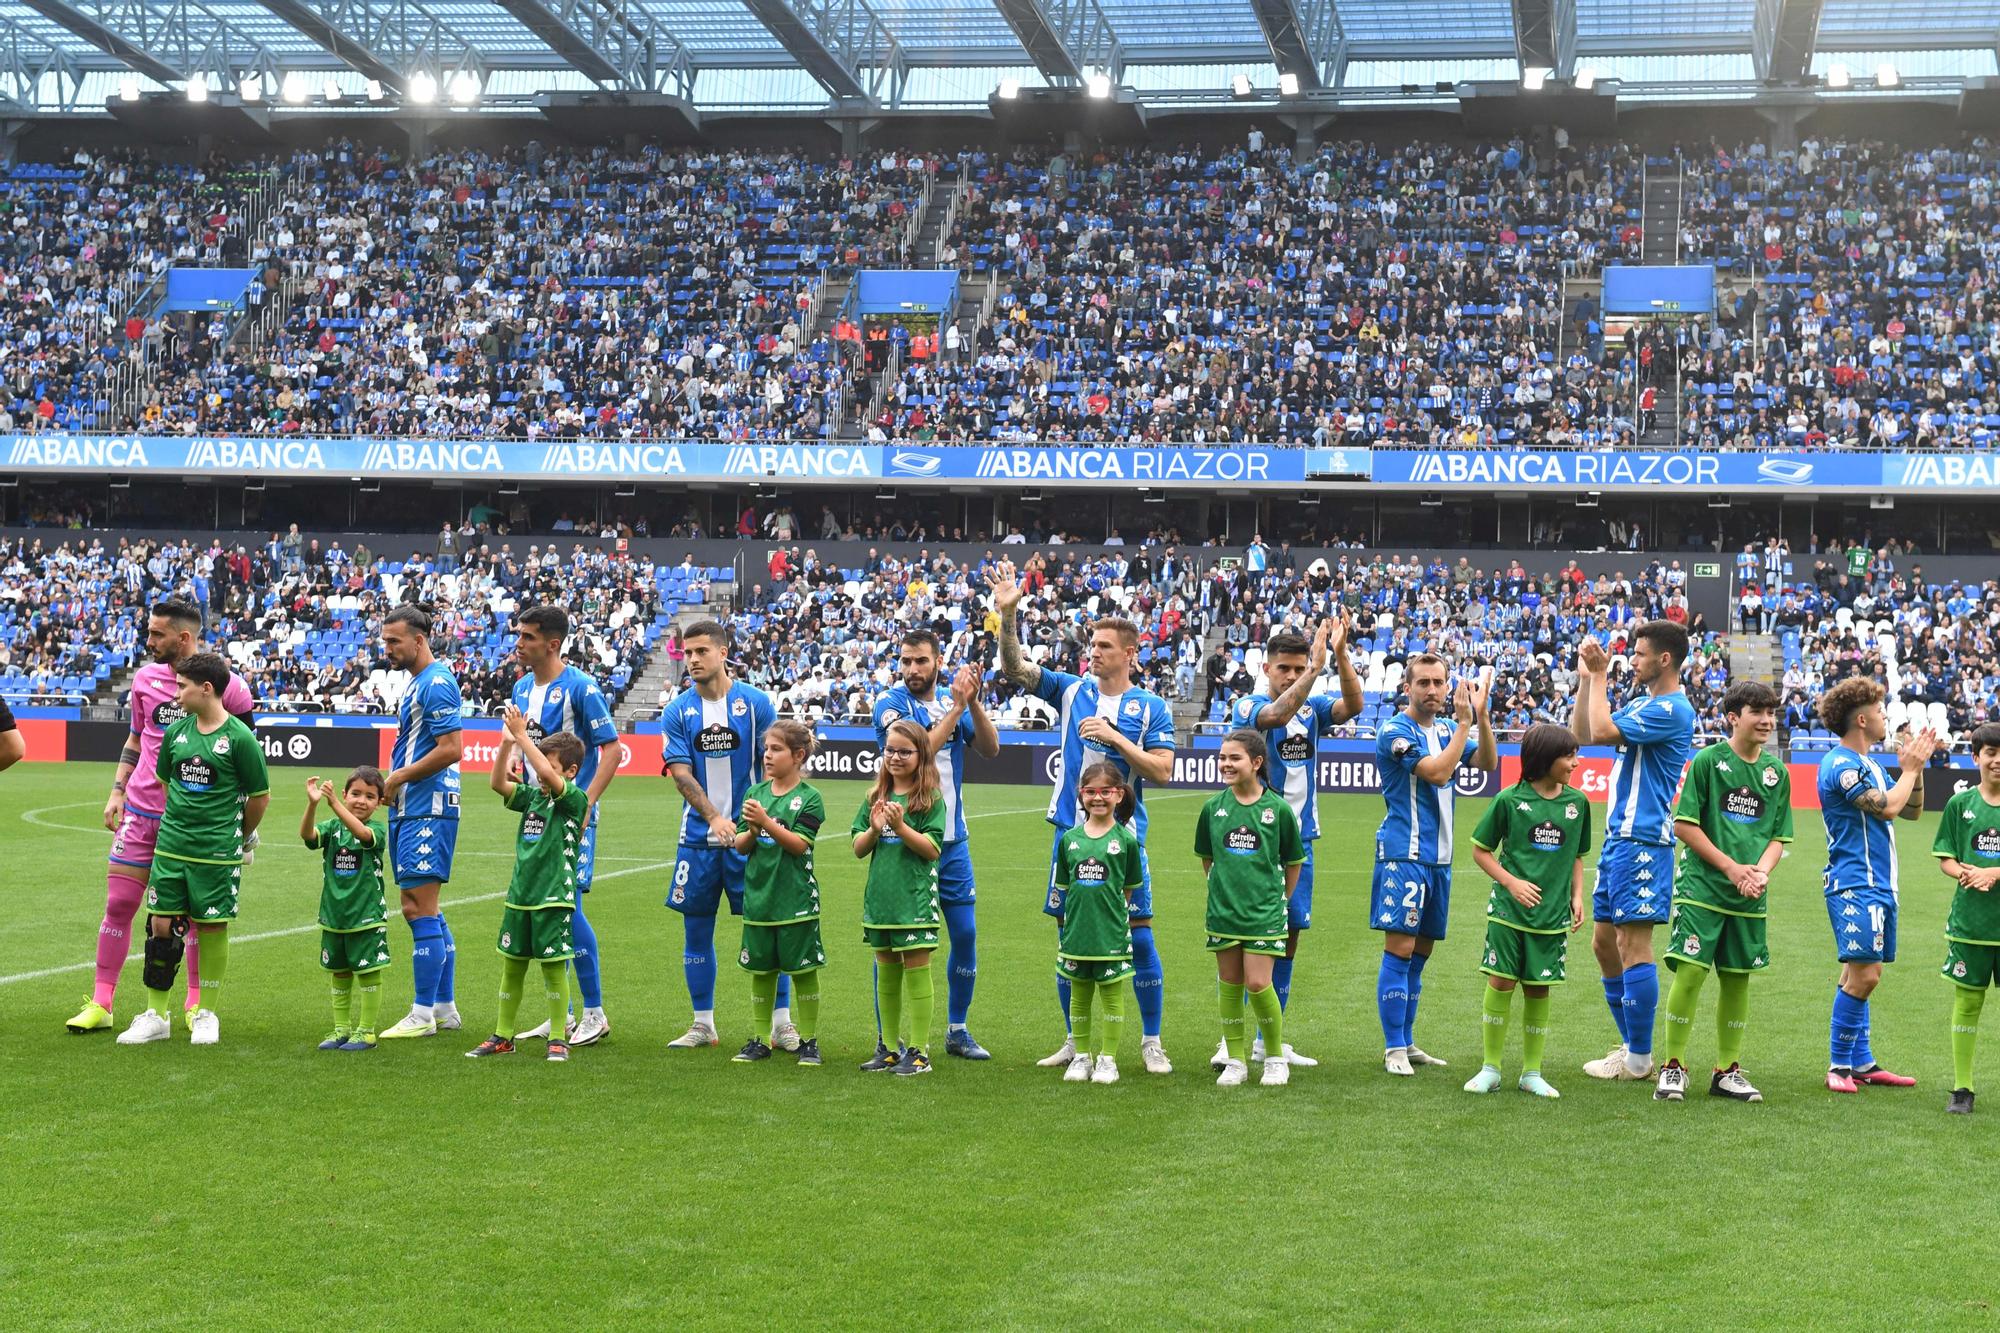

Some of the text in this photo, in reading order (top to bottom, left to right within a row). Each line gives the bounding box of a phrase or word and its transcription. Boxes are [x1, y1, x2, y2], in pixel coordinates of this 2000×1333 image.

[1133, 452, 1269, 480] RIAZOR
[1575, 455, 1719, 484] RIAZOR
[701, 732, 733, 742] Estrella
[702, 741, 732, 751] Galicia
[181, 763, 210, 776] Estrella
[181, 772, 208, 784] Galicia
[1727, 793, 1759, 807] Estrella
[1727, 802, 1756, 816] Galicia
[1229, 832, 1256, 842] Estrella
[1534, 827, 1561, 837] Estrella
[1229, 840, 1254, 849] Galicia
[1534, 835, 1559, 844] Galicia
[675, 861, 690, 886] 8
[1078, 864, 1104, 873] Estrella
[1078, 871, 1103, 880] Galicia
[1402, 881, 1426, 909] 21
